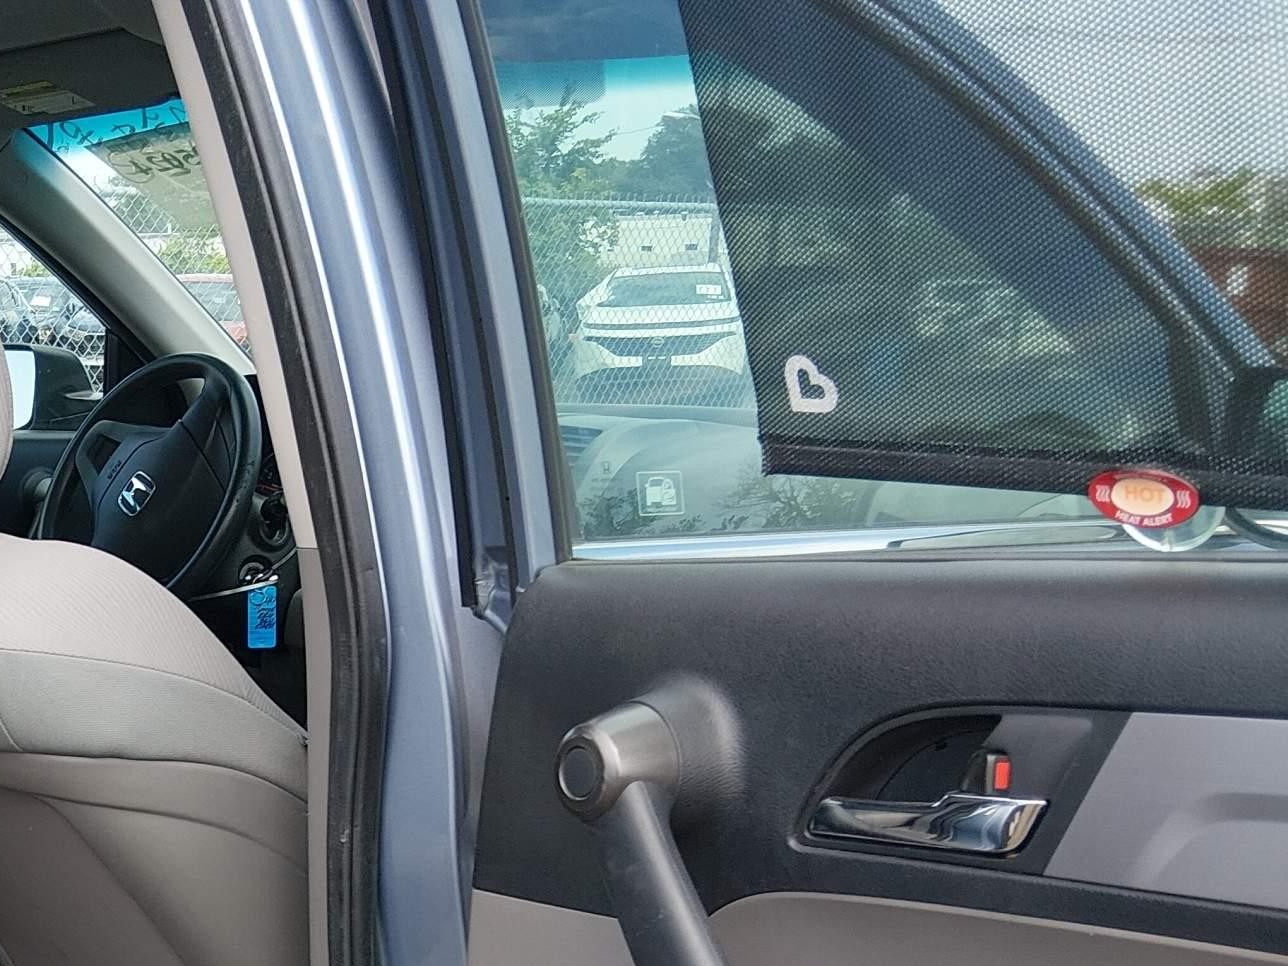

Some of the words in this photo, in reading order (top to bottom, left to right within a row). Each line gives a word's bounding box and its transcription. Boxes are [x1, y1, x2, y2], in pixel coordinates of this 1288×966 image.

[1124, 485, 1166, 503] HOT
[1114, 510, 1141, 526] HEAT
[1142, 512, 1173, 526] ALERT
